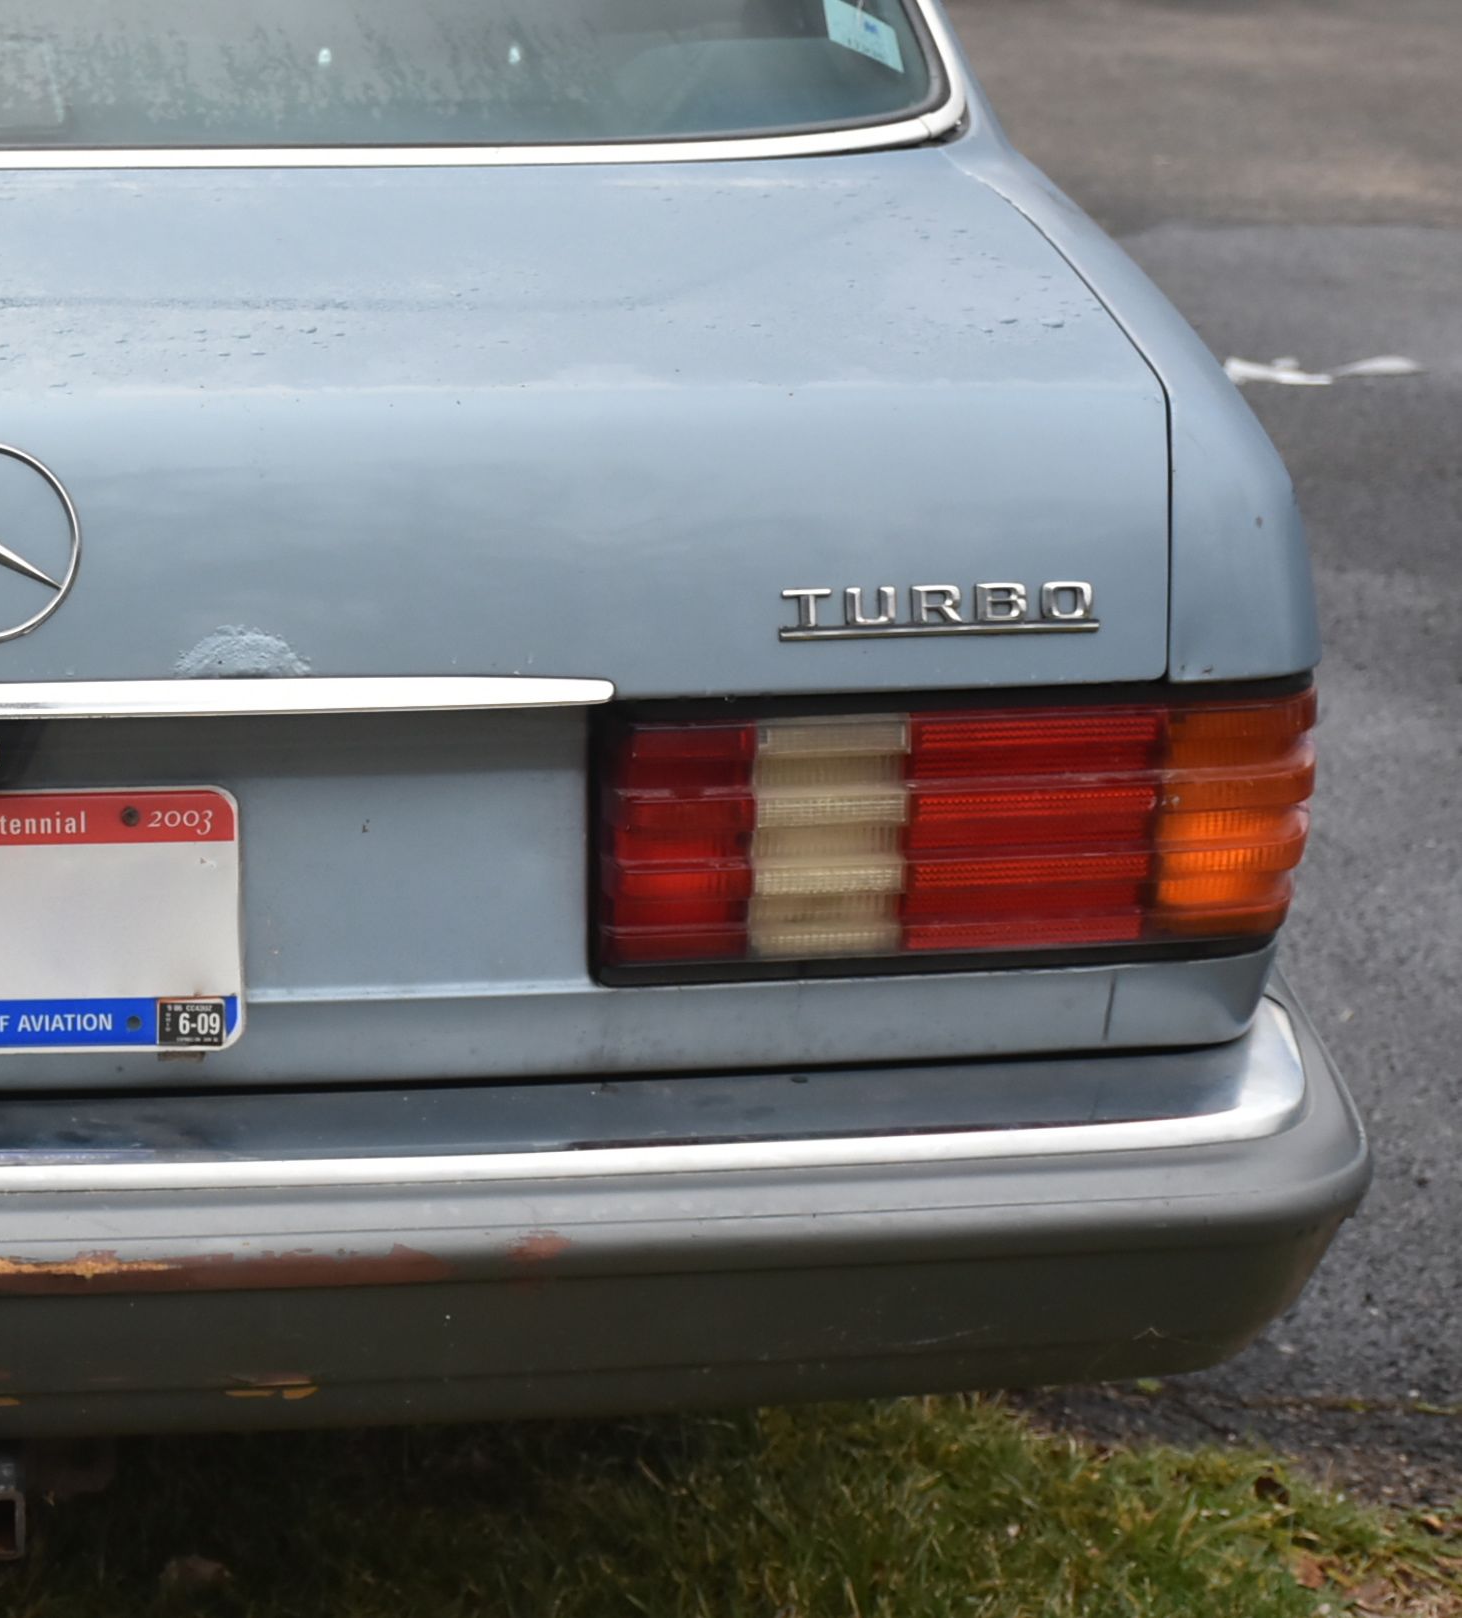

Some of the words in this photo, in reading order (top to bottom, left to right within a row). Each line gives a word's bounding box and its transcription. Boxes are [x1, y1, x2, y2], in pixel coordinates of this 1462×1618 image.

[781, 580, 1094, 628] TURBO
[147, 809, 213, 836] 2003
[17, 1013, 114, 1033] AVIATION
[178, 1012, 221, 1036] 6-09
